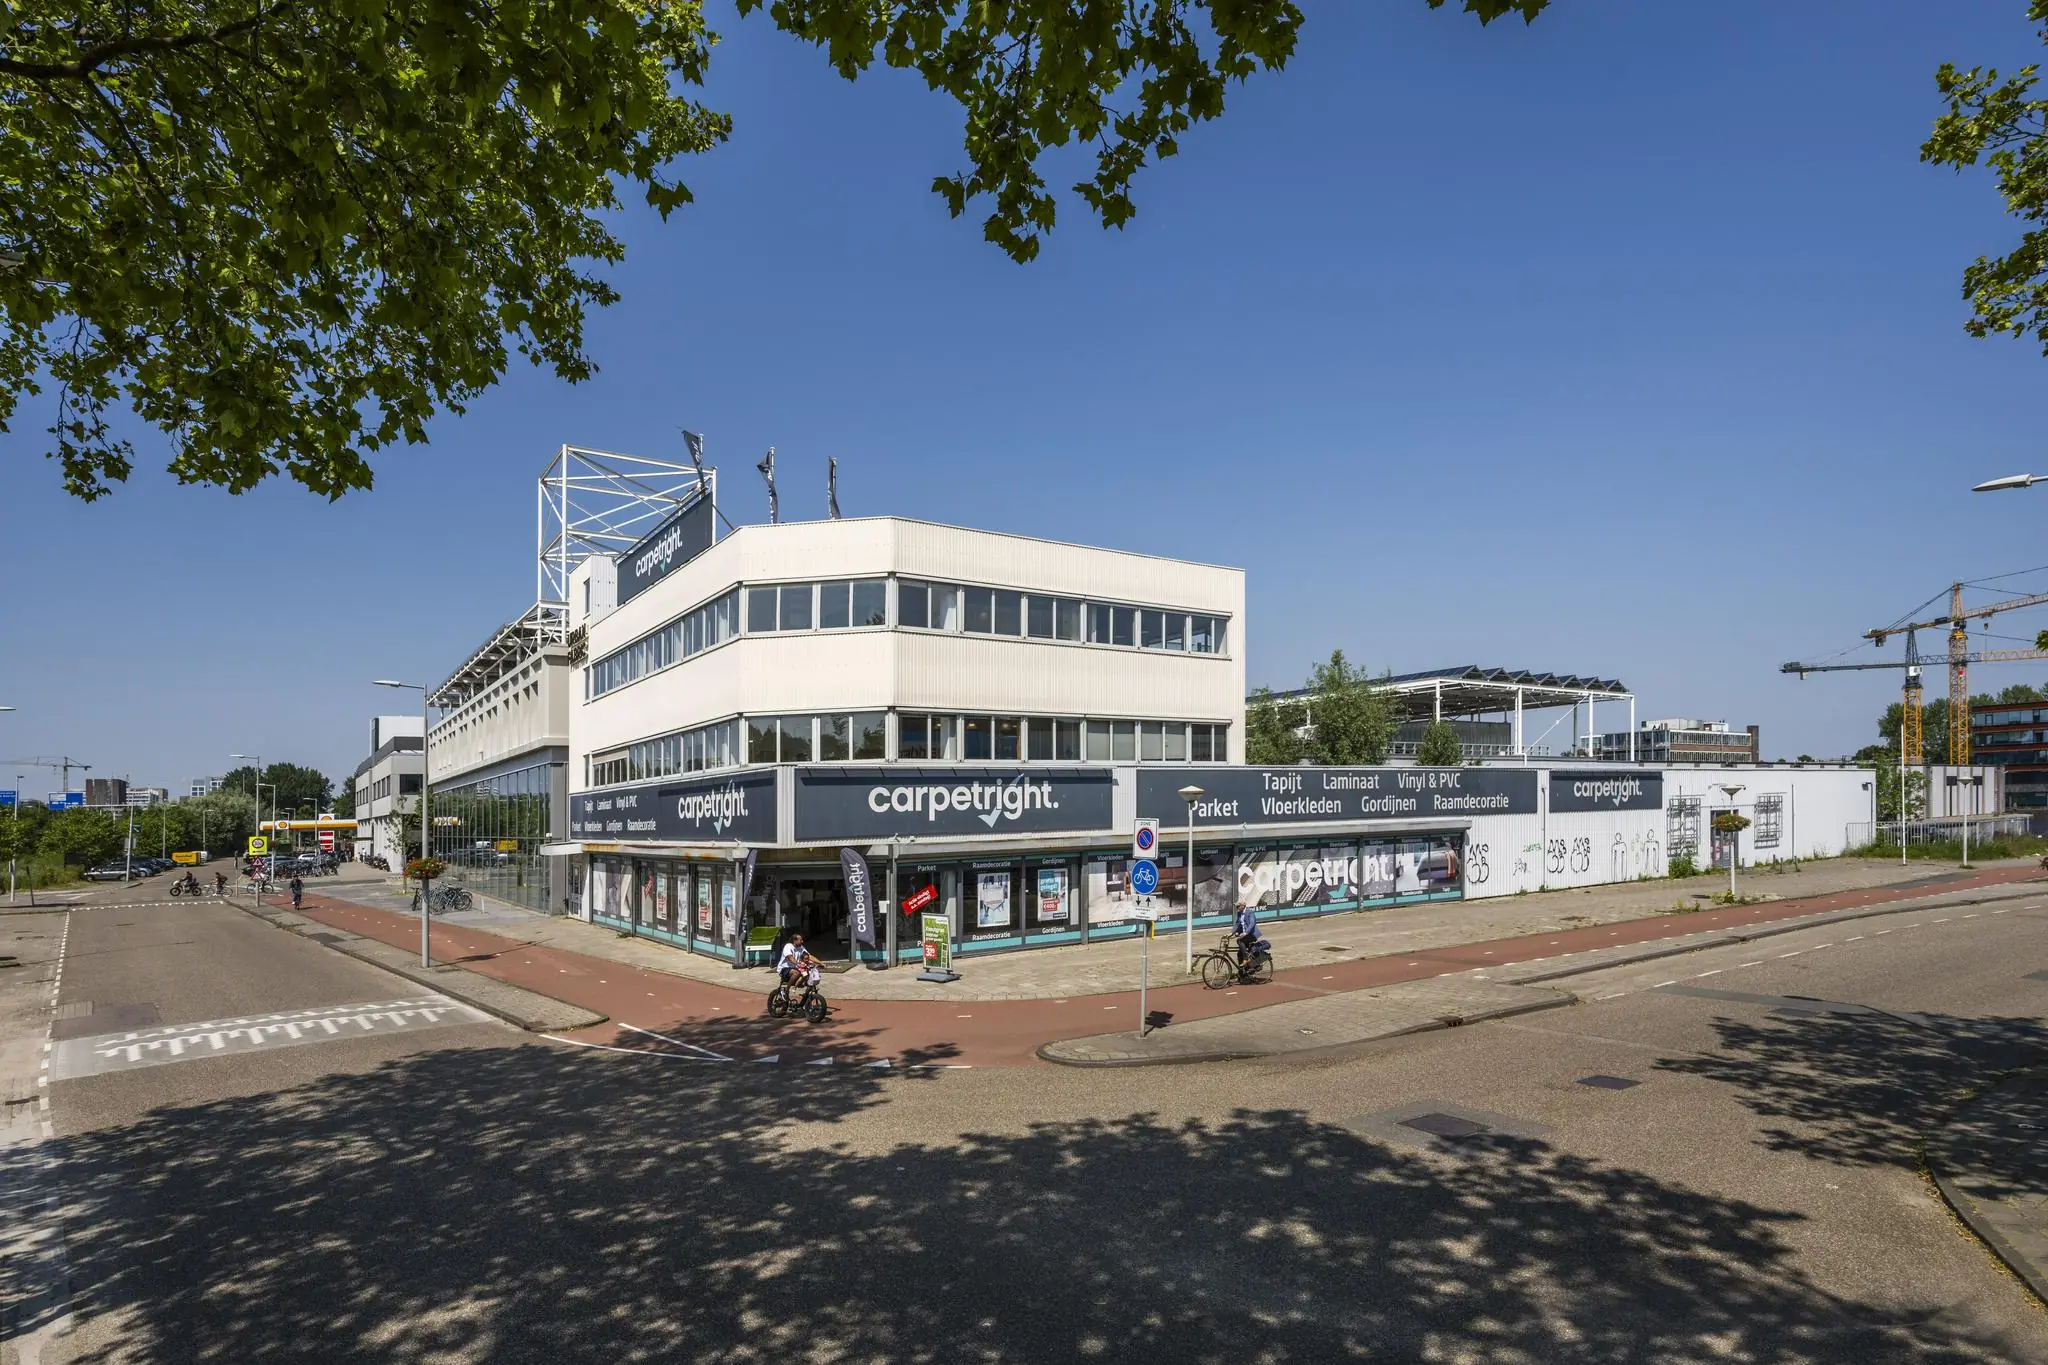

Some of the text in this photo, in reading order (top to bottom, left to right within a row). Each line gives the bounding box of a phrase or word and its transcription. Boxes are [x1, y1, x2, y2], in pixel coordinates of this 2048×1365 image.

[1263, 772, 1461, 794] Tapijt Laminaat Vinyl & PVC
[678, 782, 749, 828] carpetright.
[868, 776, 1059, 822] carpetright.
[1261, 796, 1342, 815] Vloerkleden
[1361, 795, 1417, 815] Gordijnen
[1434, 793, 1509, 810] Raamdecoratie
[627, 818, 656, 831] Raamdecoratie
[972, 860, 1011, 869] Raamdecoratie
[1097, 920, 1125, 928] Vloerkleden
[972, 931, 1011, 941] Raamdecoratie
